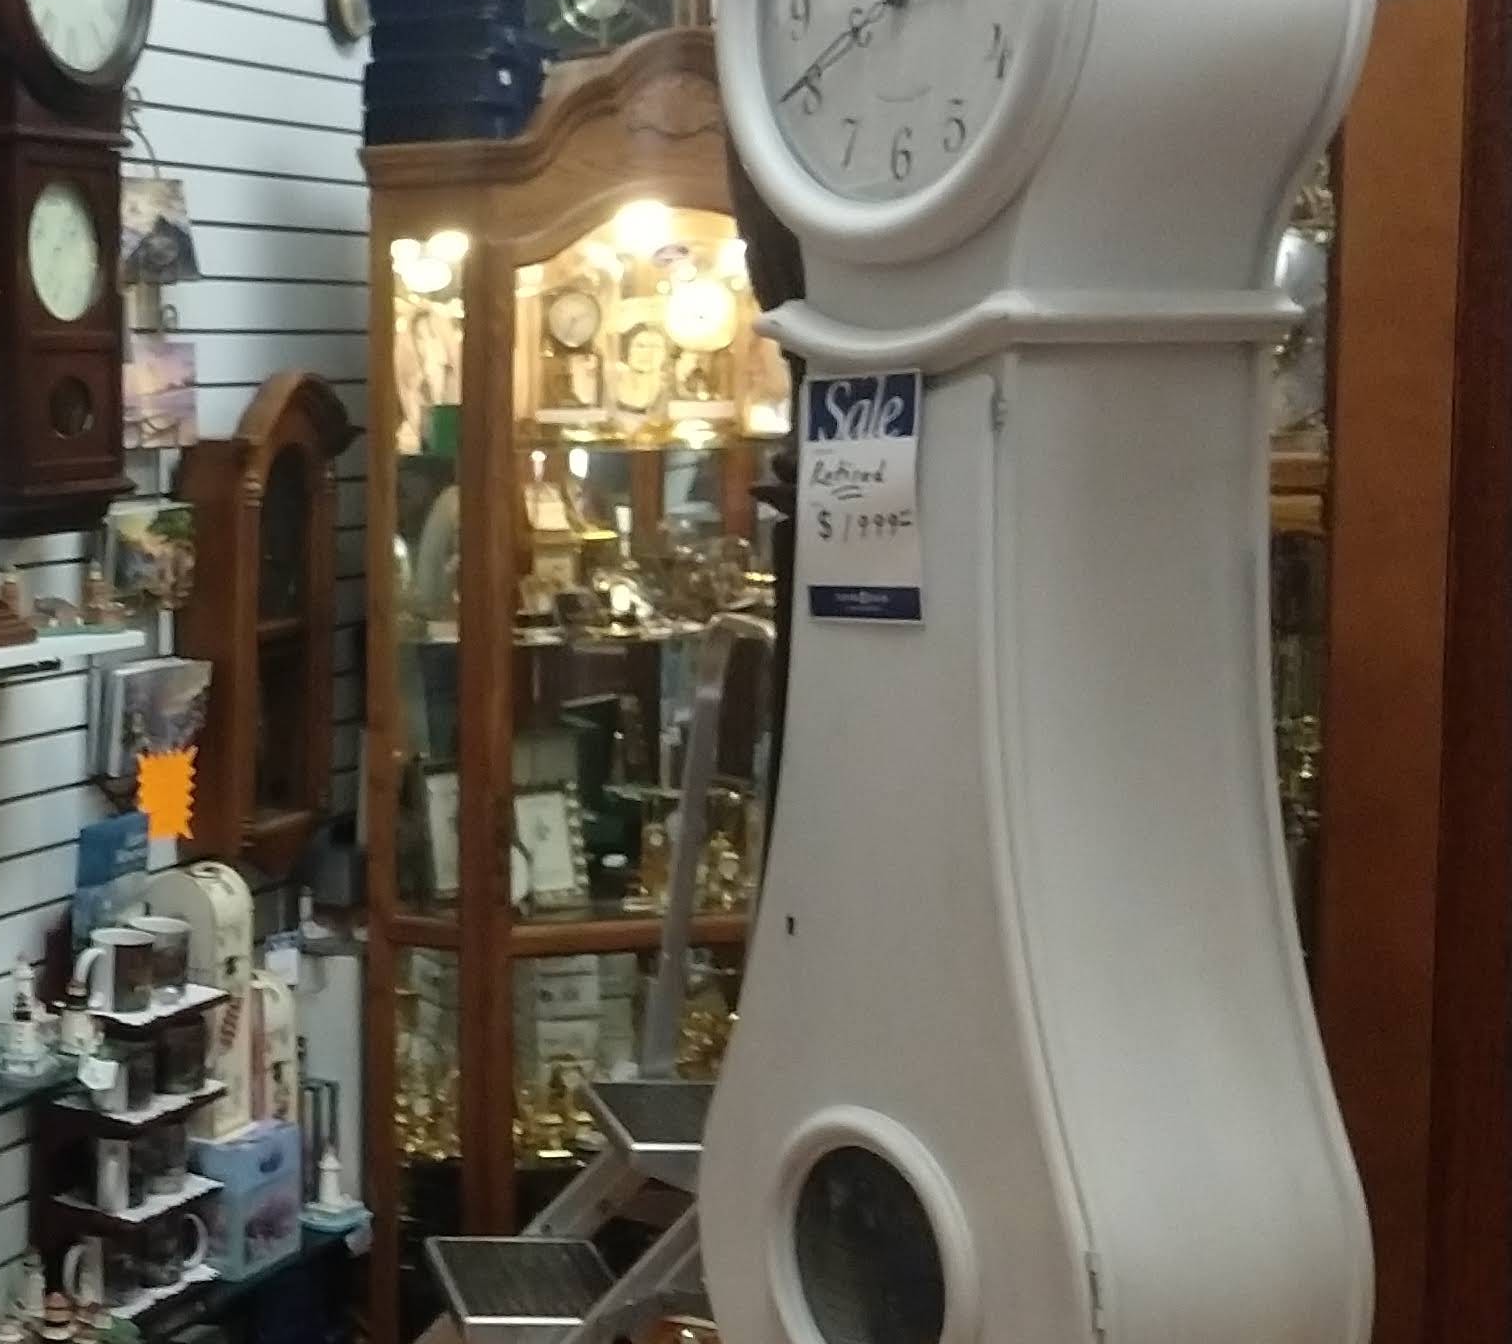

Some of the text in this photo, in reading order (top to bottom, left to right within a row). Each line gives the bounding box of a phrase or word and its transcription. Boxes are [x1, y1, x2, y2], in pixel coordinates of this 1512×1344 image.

[984, 22, 1010, 80] 4
[838, 118, 859, 169] 7
[889, 125, 914, 182] 6
[943, 99, 968, 153] 5
[819, 374, 907, 440] Sale
